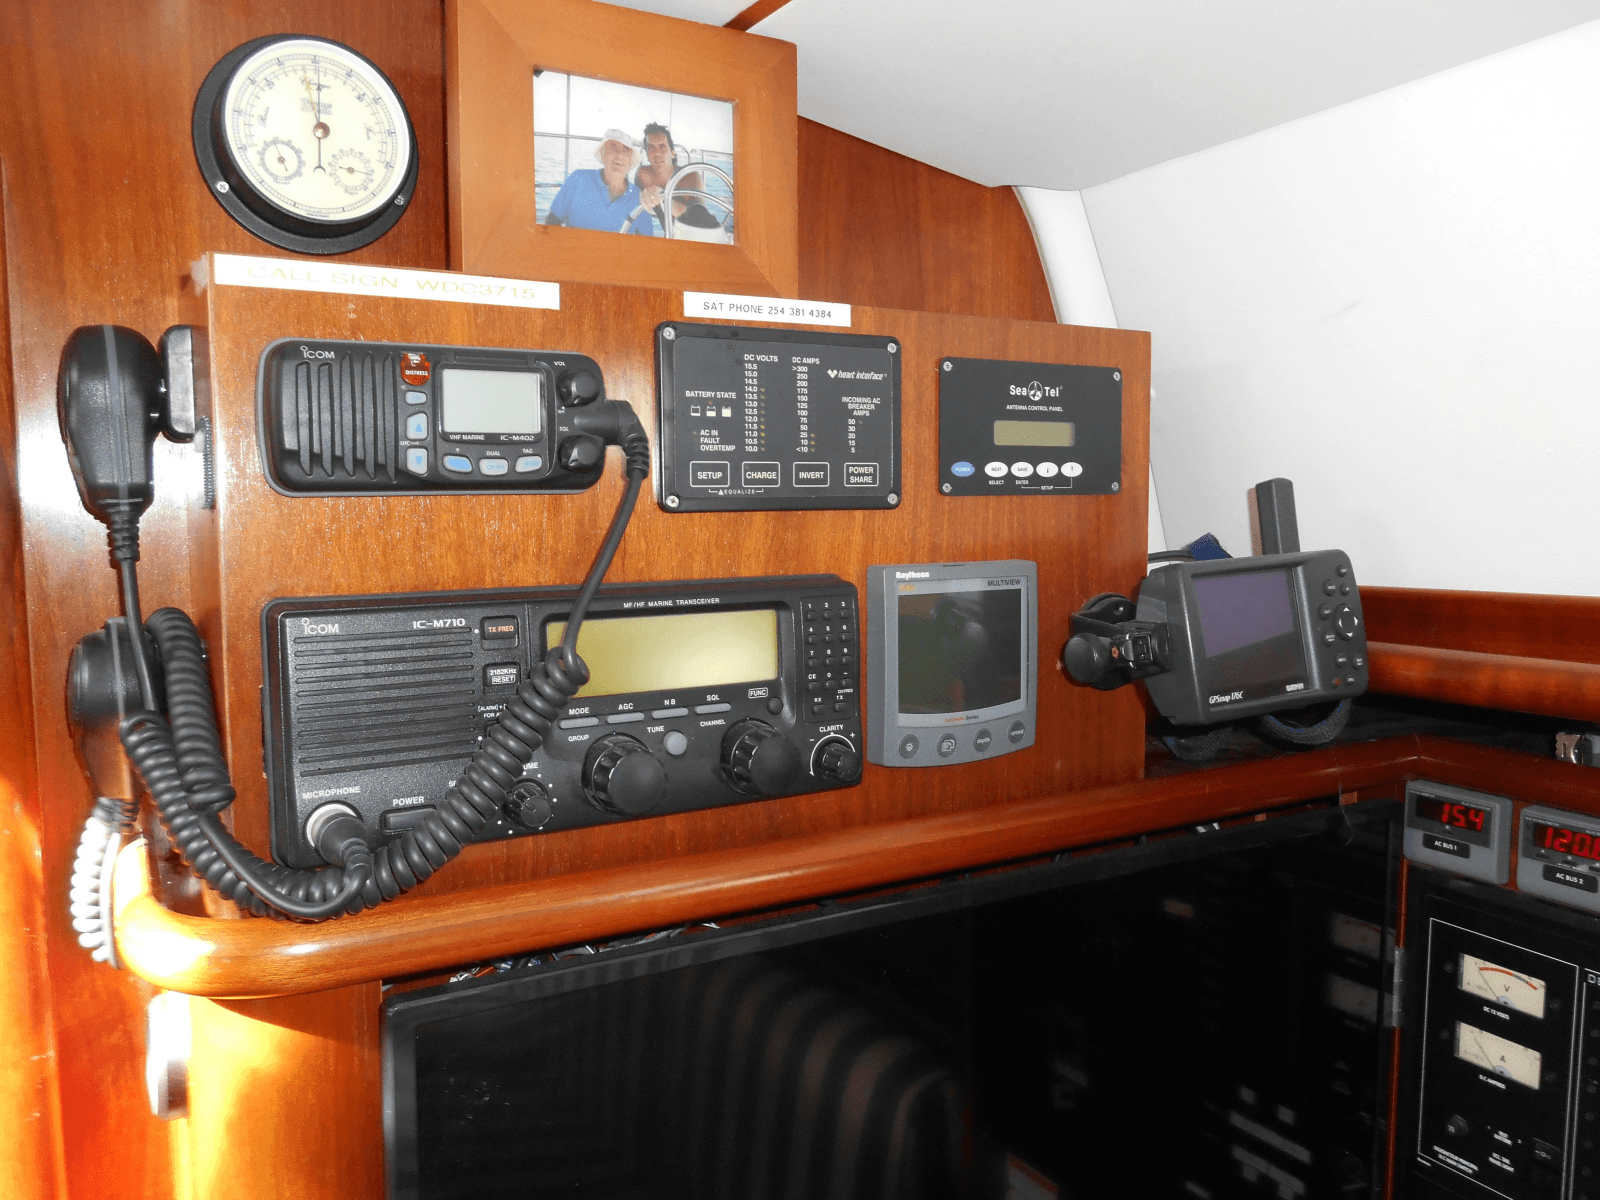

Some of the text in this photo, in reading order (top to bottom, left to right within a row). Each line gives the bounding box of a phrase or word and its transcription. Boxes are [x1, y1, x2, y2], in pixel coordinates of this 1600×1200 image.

[247, 266, 535, 300] CALL SIGN WDC3715
[703, 302, 832, 318] SAT PHONE 254 381 4384
[838, 370, 884, 380] heart interface
[1010, 385, 1059, 397] Sea Tel
[896, 572, 929, 580] Raytheon
[413, 618, 465, 629] IC-M710
[1286, 683, 1304, 692] GARMIN
[1209, 694, 1230, 704] GPSmap
[819, 725, 843, 733] CLARITY
[302, 786, 361, 800] MICROPHONE
[392, 796, 424, 806] POWER
[1442, 803, 1485, 832] 154
[1566, 874, 1577, 883] BUS
